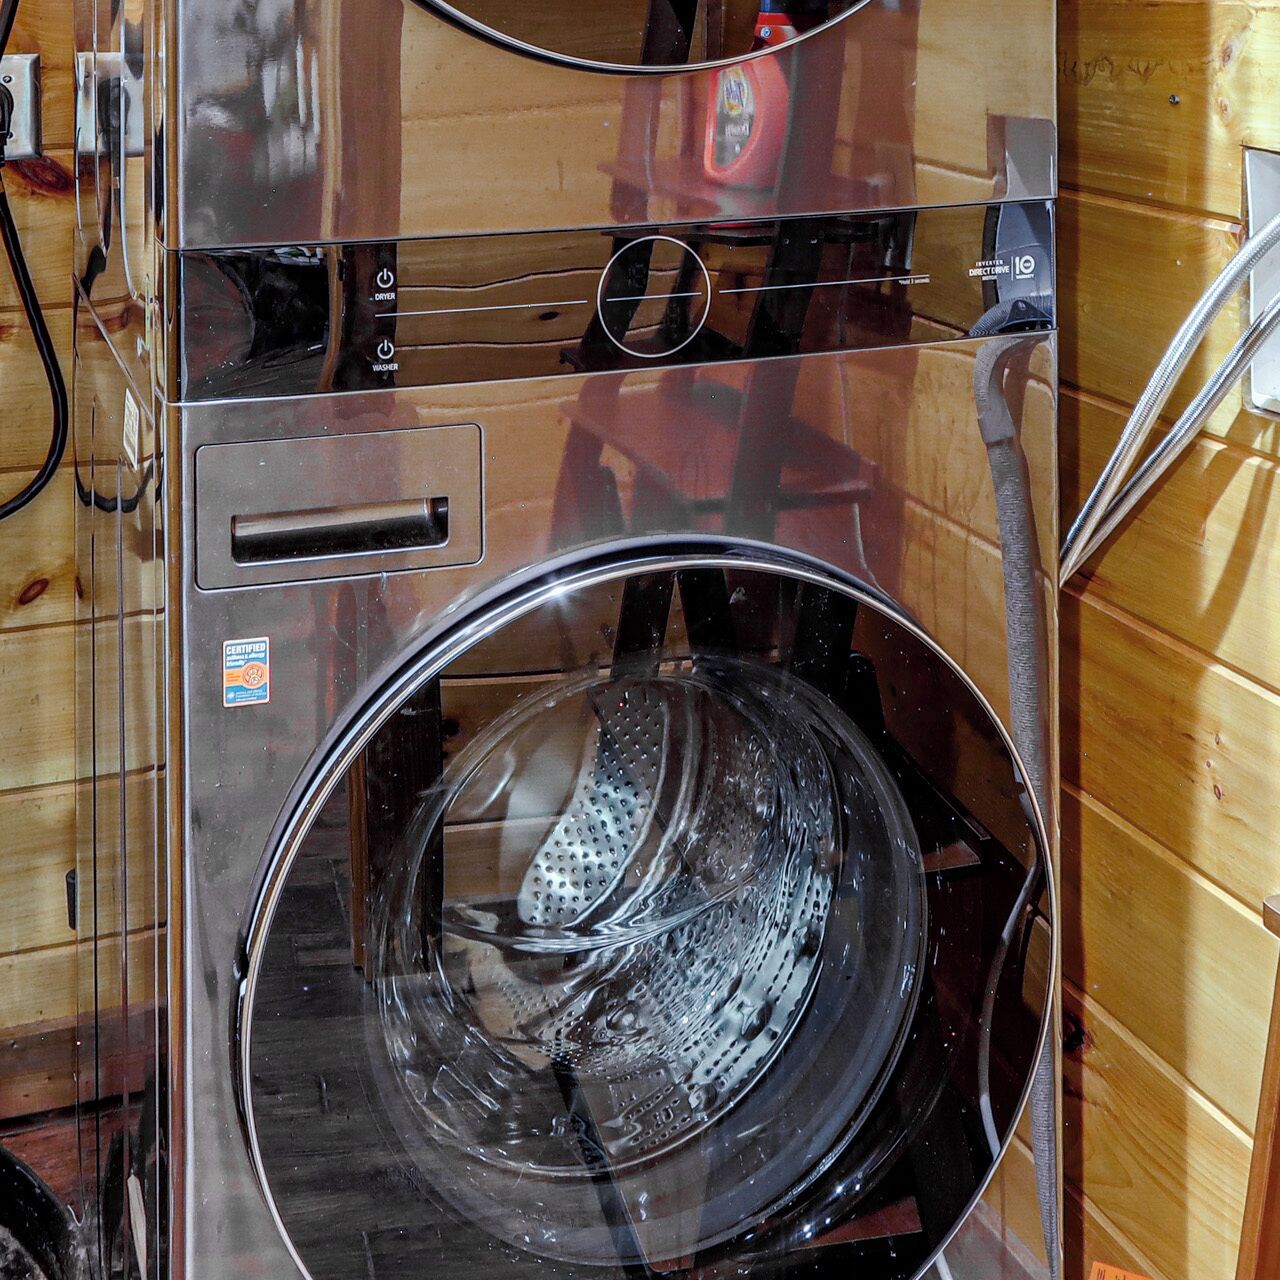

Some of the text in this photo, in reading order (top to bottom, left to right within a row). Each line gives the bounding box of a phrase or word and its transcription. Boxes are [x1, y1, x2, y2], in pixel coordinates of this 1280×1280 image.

[968, 265, 1010, 277] DIRECT DRIVE
[1015, 255, 1036, 275] 10
[374, 292, 396, 301] DRYER
[372, 363, 399, 372] WASHER
[226, 643, 266, 655] CERTIFIED
